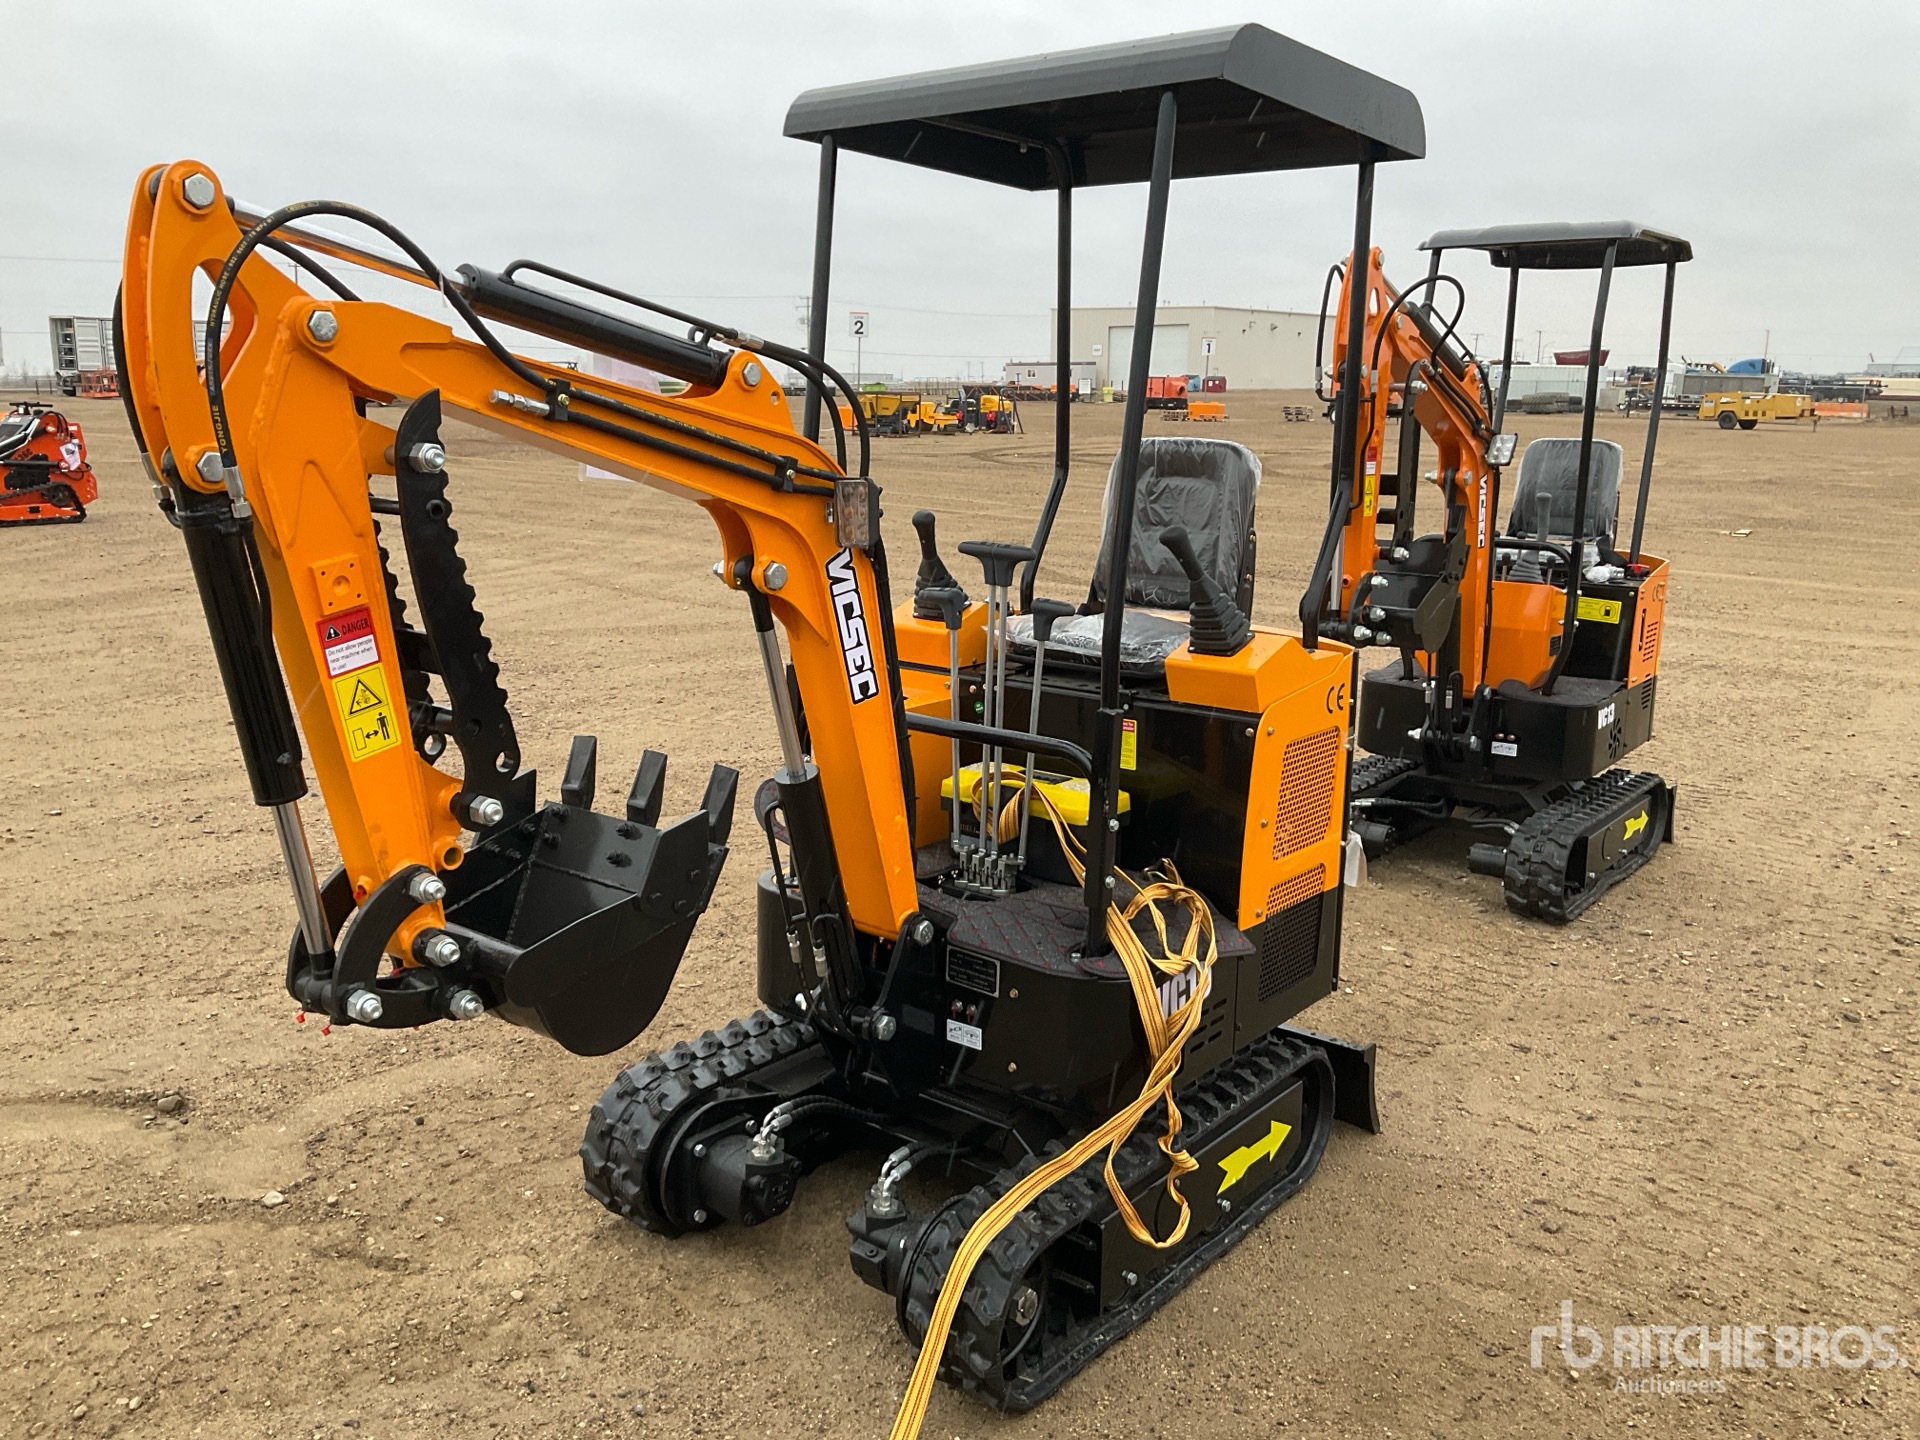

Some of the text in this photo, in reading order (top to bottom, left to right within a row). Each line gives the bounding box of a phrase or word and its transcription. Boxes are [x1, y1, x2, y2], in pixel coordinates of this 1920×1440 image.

[854, 320, 864, 335] 2
[1206, 342, 1211, 354] 1
[212, 405, 228, 454] YONGJIE
[341, 617, 369, 635] DANGER
[826, 547, 879, 703] VICSEC
[357, 638, 373, 648] people
[341, 651, 360, 660] machine
[361, 646, 373, 654] when
[1327, 683, 1345, 714] CE
